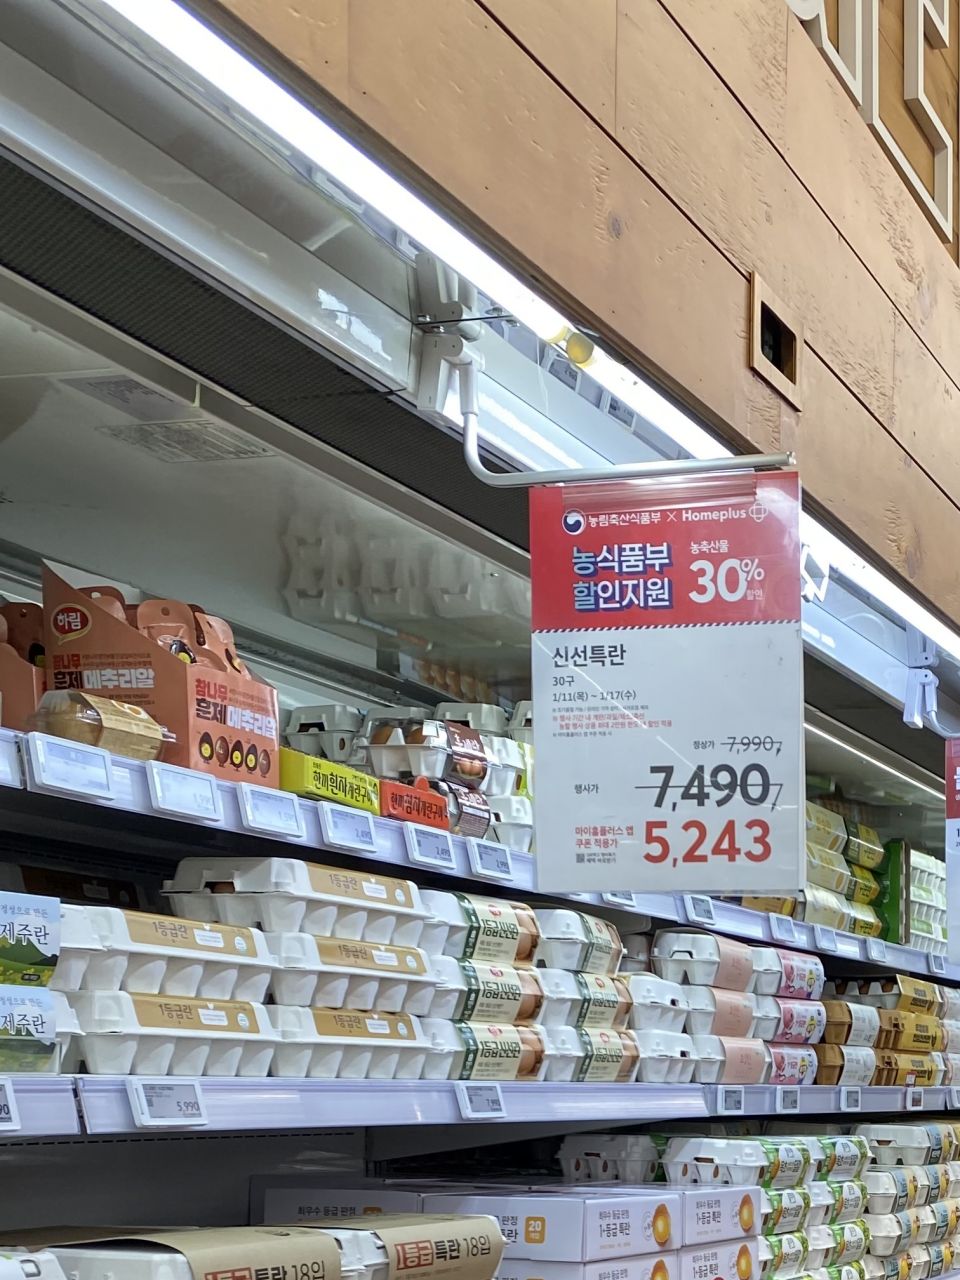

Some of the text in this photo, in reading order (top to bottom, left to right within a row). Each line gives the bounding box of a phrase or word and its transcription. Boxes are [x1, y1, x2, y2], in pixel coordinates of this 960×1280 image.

[588, 509, 747, 528] 농림축산식품부 Homeplus
[690, 540, 729, 554] 농축산물
[572, 542, 670, 575] 농식품부
[573, 577, 671, 610] 할인지원
[57, 612, 82, 630] 하림
[553, 644, 627, 668] 신선특란
[82, 668, 155, 690] 메추리알
[552, 675, 575, 687] 30구
[195, 678, 228, 700] 참나무
[196, 698, 226, 726] 훈제
[226, 705, 277, 739] 메추리알
[727, 736, 774, 754] 7,990
[574, 763, 771, 812] 행사가 7,490
[575, 826, 625, 837] 마이홈플러스
[575, 839, 592, 849] 쿠폰
[643, 818, 772, 868] 5,243
[329, 873, 358, 891] 1등급란
[1, 922, 49, 945] 제주란
[153, 921, 188, 939] 1등급란
[337, 944, 367, 960] 1등급란
[160, 1004, 193, 1020] 1등급란
[1, 1013, 46, 1035] 제주란
[177, 1101, 200, 1113] 5,990
[323, 1206, 339, 1216] 등급
[528, 1221, 541, 1231] 20
[394, 1234, 491, 1270] 1등급 특란 18입
